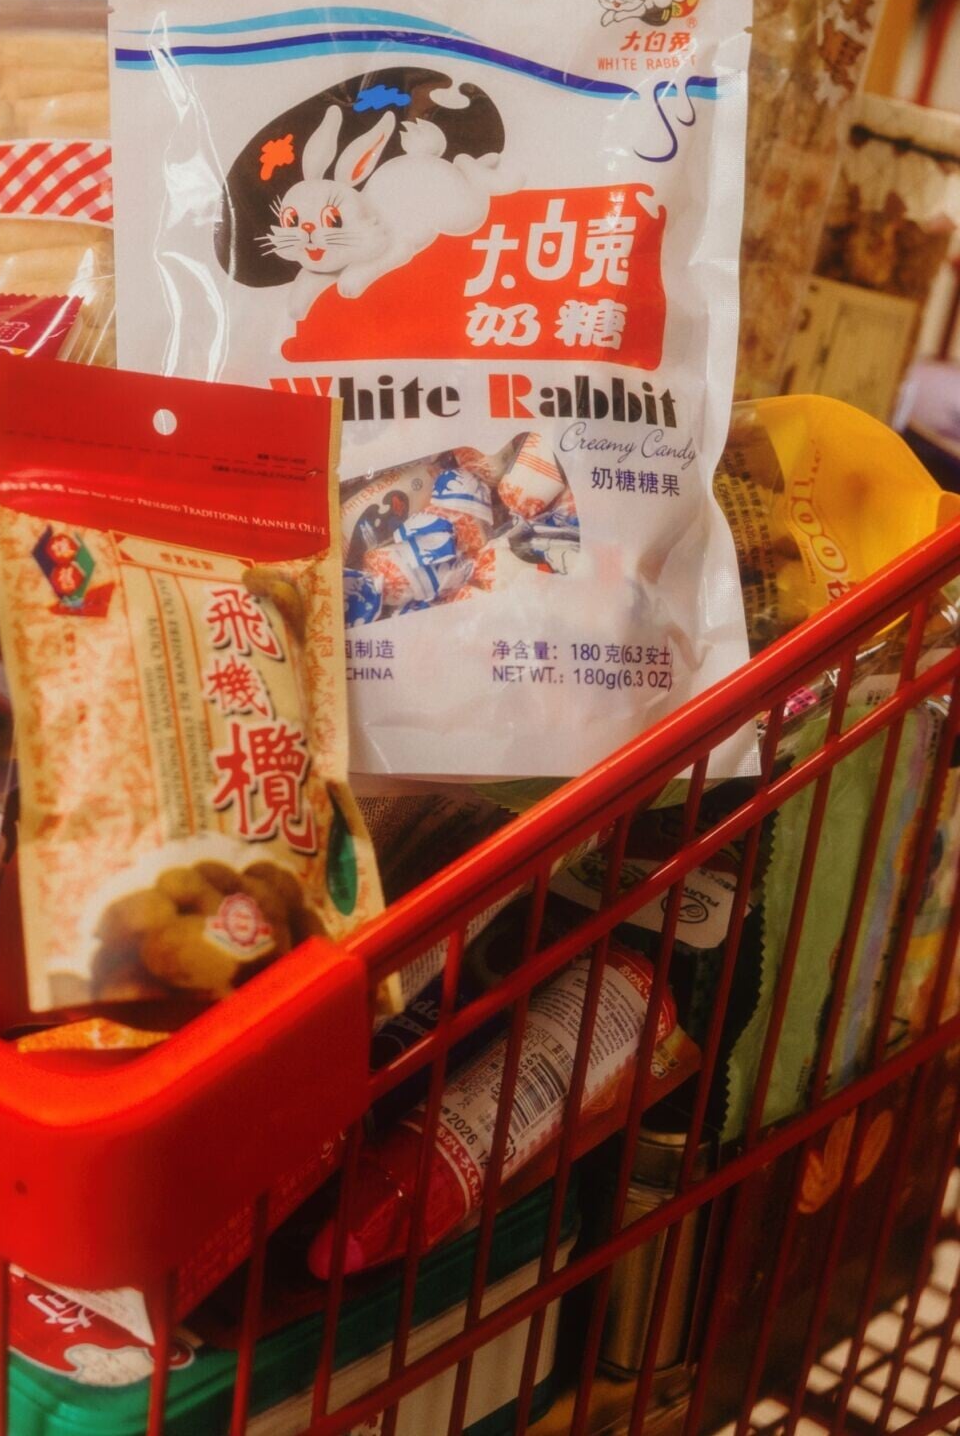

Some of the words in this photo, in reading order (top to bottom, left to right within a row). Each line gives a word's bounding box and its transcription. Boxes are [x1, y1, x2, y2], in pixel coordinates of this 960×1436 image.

[620, 31, 692, 52] 大白兔
[597, 58, 638, 71] WHITE
[646, 56, 698, 70] RABBT
[464, 199, 633, 298] 大白兔
[465, 301, 626, 351] 奶糖
[488, 373, 679, 429] Rabbit
[559, 421, 637, 463] Creamy
[640, 428, 698, 471] Candy
[590, 466, 682, 498] 奶糖糖果
[182, 504, 249, 525] TRADITIONAL
[251, 516, 297, 532] MANNER
[571, 643, 601, 662] 180
[346, 667, 396, 682] CHINA
[492, 666, 526, 684] NET
[446, 1111, 480, 1147] 2026
